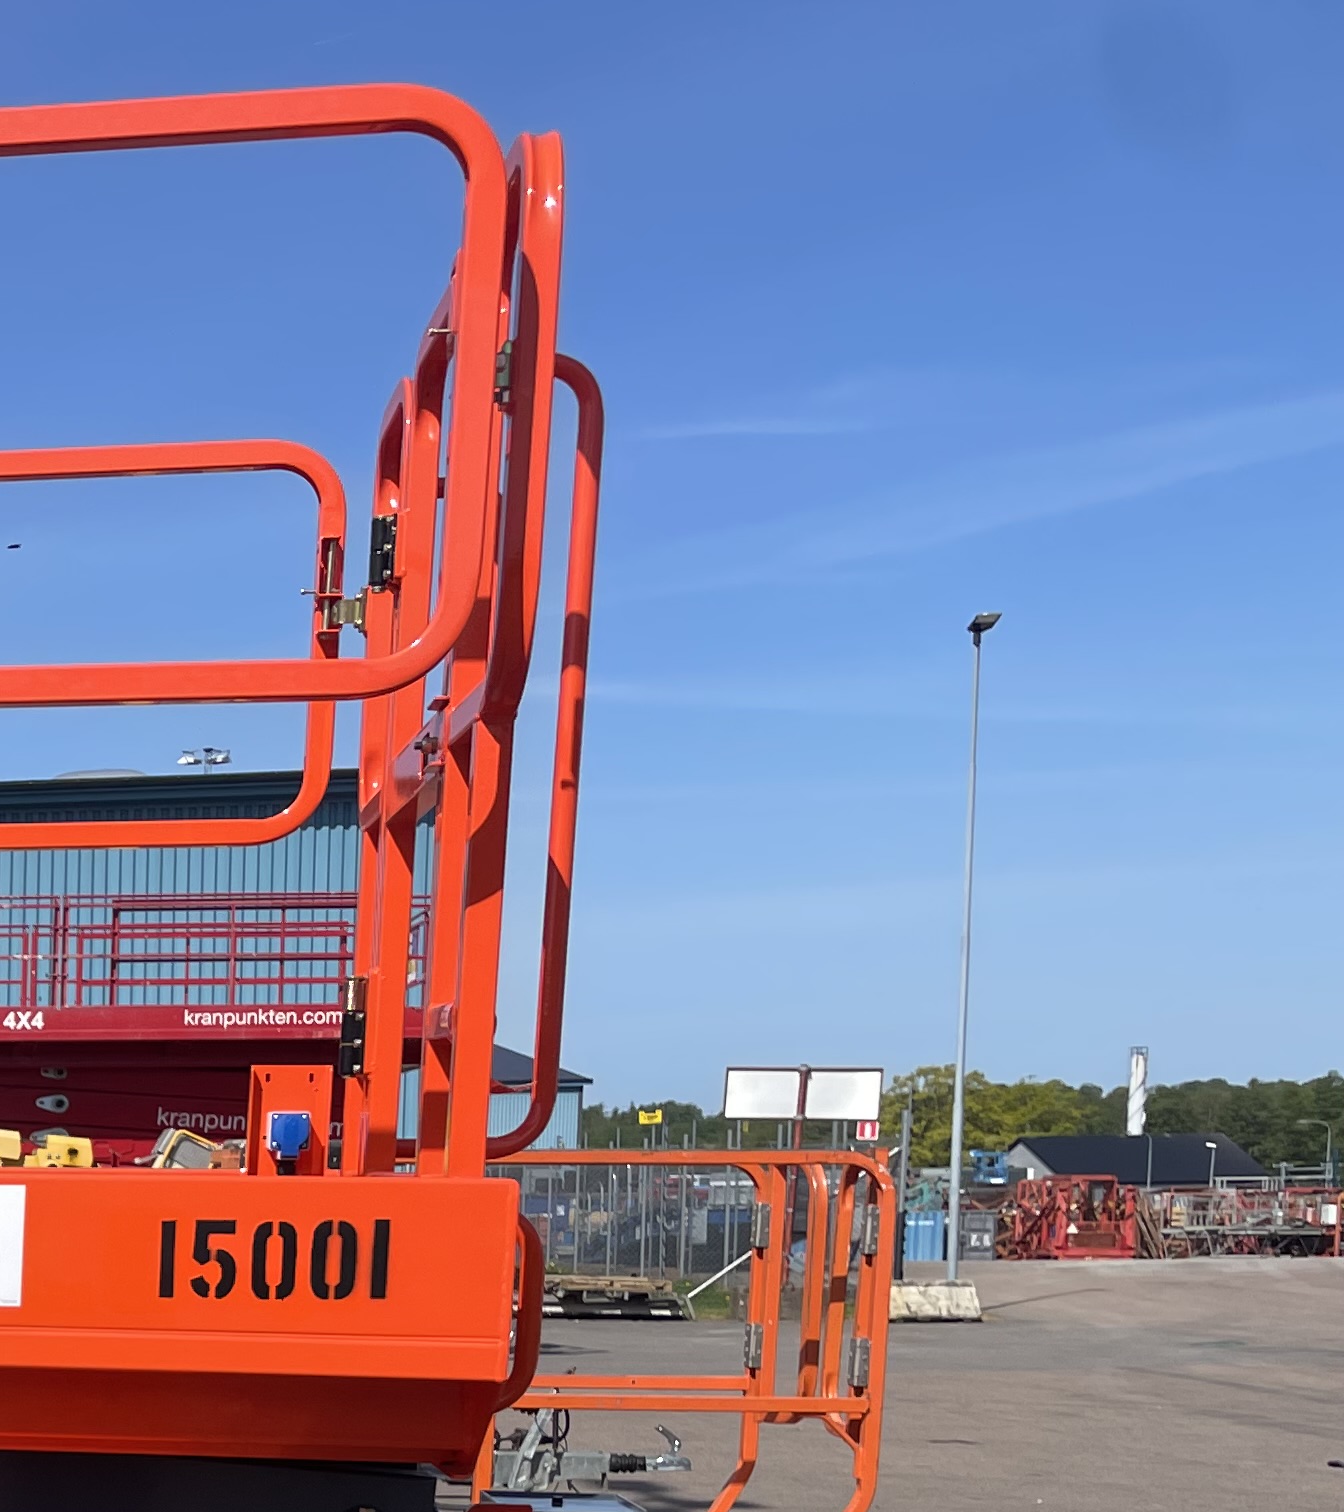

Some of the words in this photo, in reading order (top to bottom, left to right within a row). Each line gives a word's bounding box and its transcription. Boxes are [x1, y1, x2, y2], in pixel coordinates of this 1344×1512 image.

[3, 1012, 45, 1030] 4X4
[184, 1009, 344, 1030] kranpunkten.com
[158, 1218, 391, 1300] 15001
